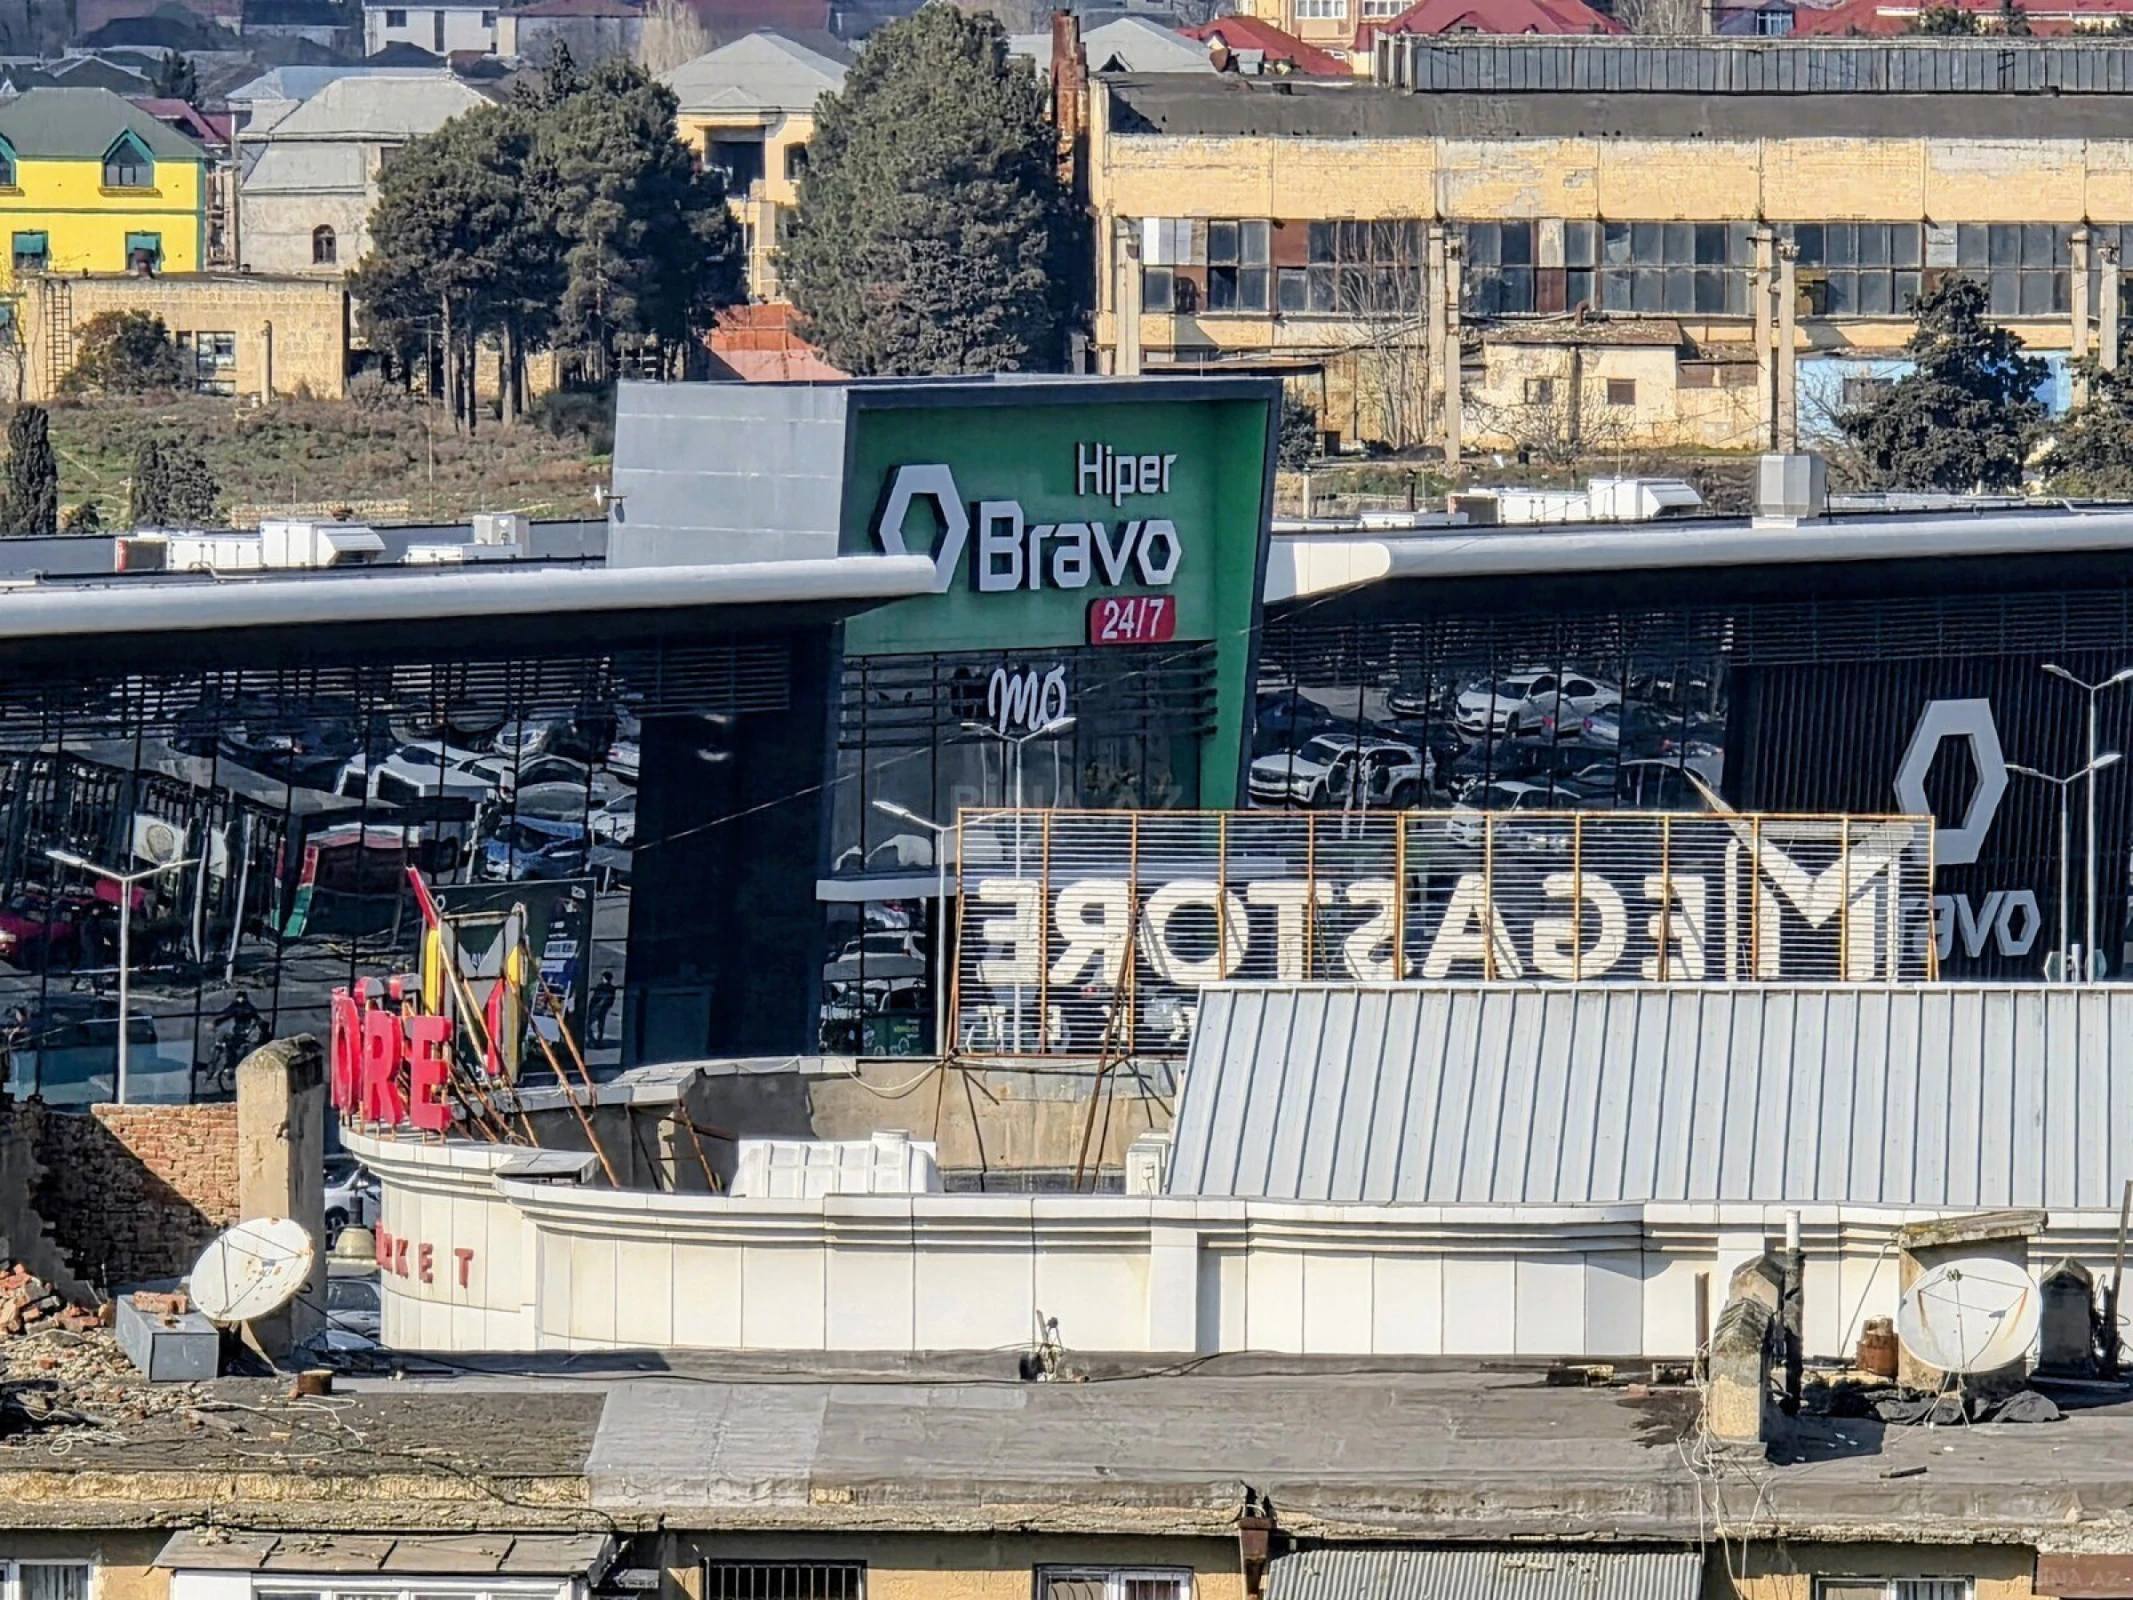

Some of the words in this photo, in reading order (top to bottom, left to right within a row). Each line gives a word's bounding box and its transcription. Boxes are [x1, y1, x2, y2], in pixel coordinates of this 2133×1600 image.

[1077, 441, 1178, 508] Hiper
[979, 500, 1183, 592] Bravo
[1101, 597, 1165, 640] 24/7
